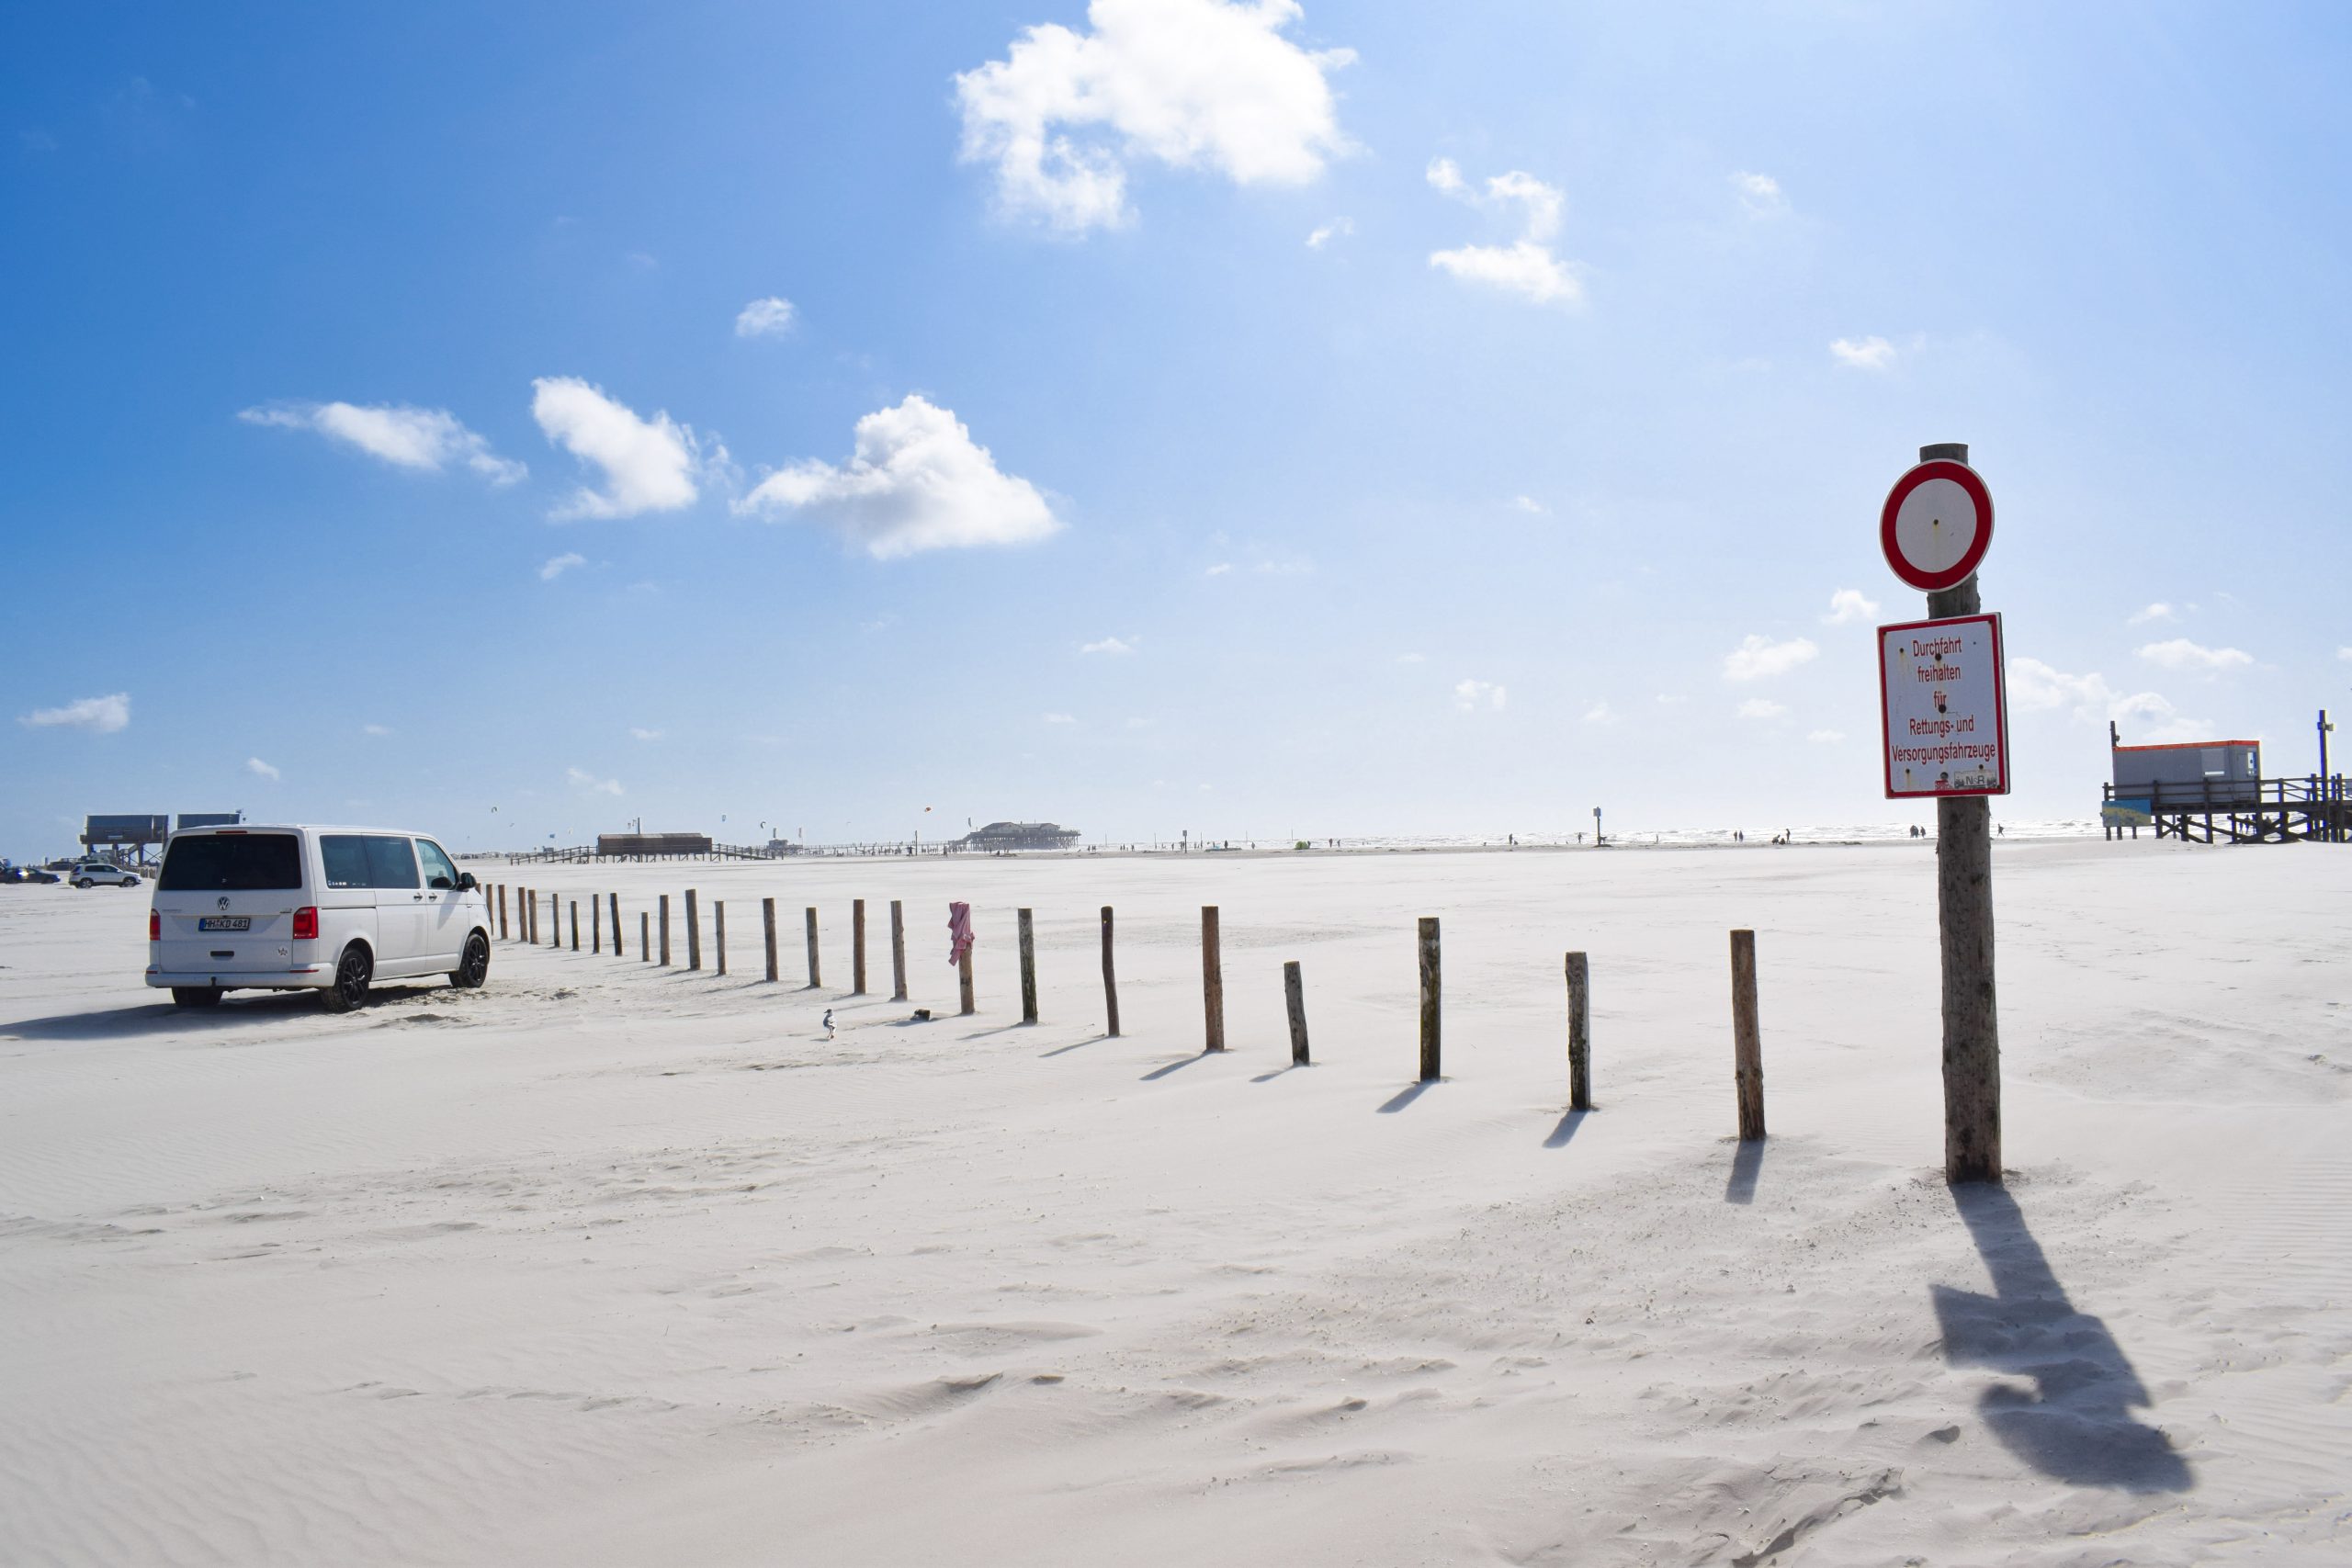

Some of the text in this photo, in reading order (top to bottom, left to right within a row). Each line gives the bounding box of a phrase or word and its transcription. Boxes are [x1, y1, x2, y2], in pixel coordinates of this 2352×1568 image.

[1912, 637, 1962, 657] Durchfahrt
[1917, 663, 1962, 682] freihalten
[1933, 691, 1947, 708] für
[1909, 715, 1974, 738] Rettungs- und
[1892, 742, 1996, 765] Versorgungsfahrzeuge
